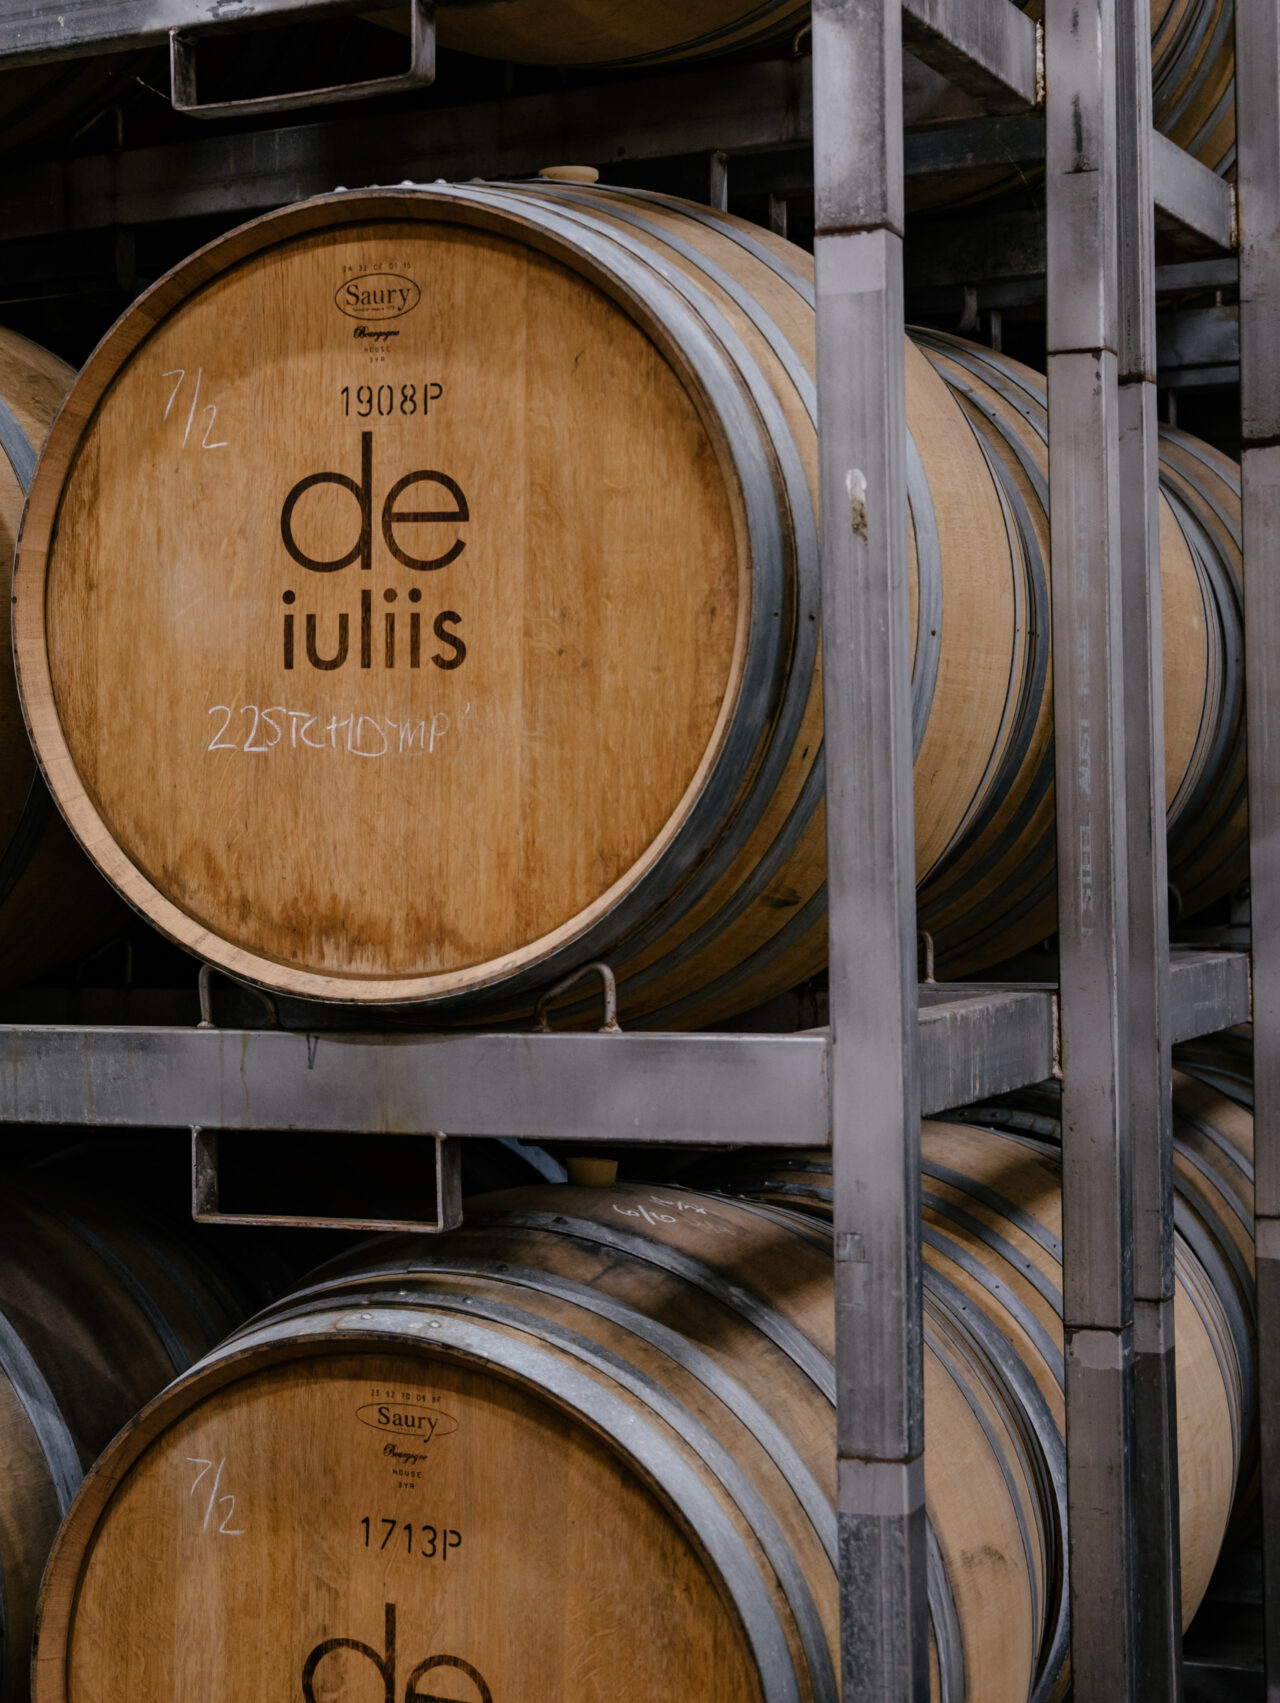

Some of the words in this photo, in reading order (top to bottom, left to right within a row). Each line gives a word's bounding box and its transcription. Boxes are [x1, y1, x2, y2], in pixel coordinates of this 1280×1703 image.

[346, 284, 410, 312] Saury
[341, 382, 443, 418] 1908P
[280, 431, 470, 573] de
[282, 587, 468, 671] iuliis
[377, 1406, 438, 1443] Saury
[392, 1468, 423, 1479] HOUSE
[361, 1516, 462, 1561] 1713P
